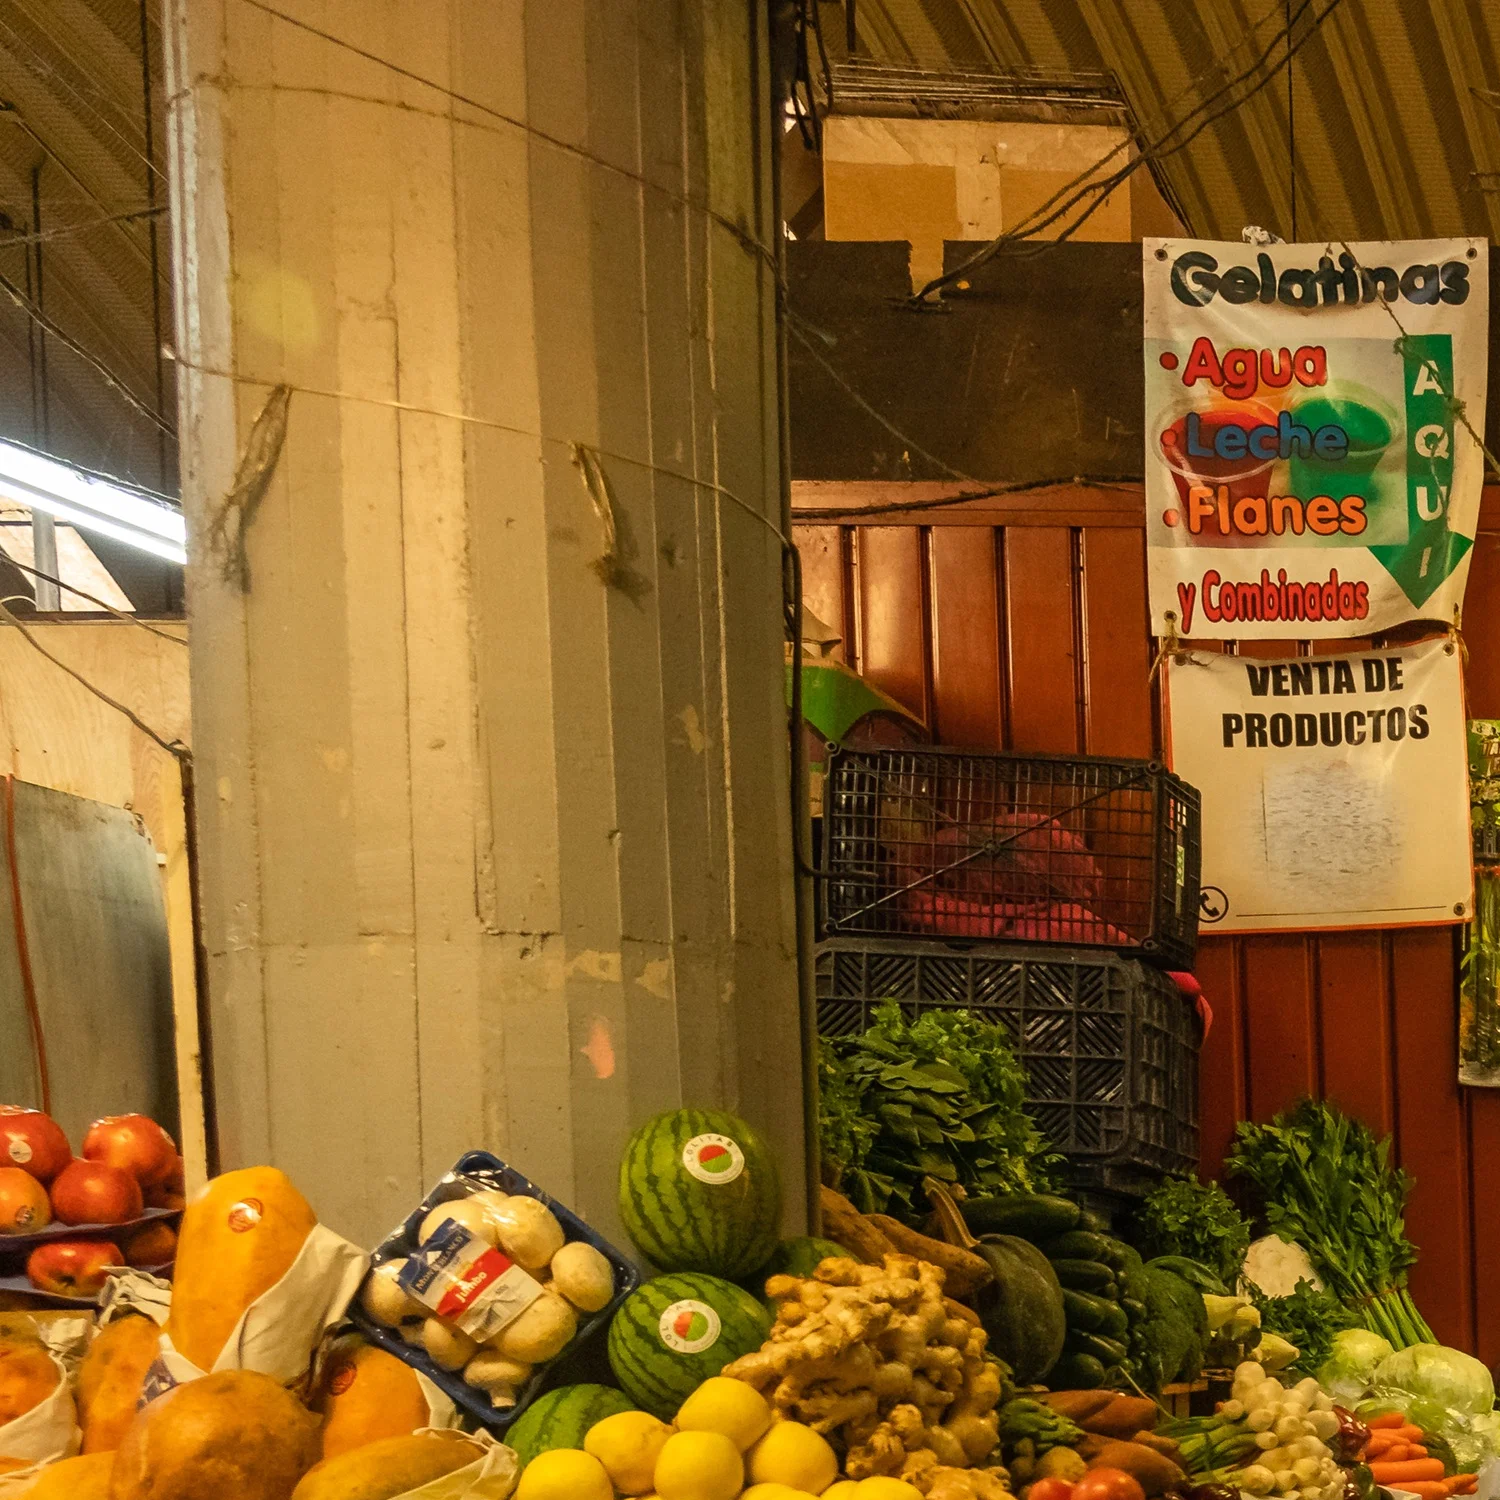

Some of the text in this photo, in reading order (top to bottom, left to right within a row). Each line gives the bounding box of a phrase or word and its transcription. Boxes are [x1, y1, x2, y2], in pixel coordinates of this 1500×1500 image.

[1170, 250, 1471, 307] Gelatinas
[1182, 336, 1329, 401] Agua
[1186, 411, 1350, 462] Leche
[1187, 484, 1368, 537] Flanes
[1177, 568, 1370, 634] y Combinadas
[1245, 656, 1404, 697] VENTA DE
[1222, 703, 1430, 748] PRODUCTOS
